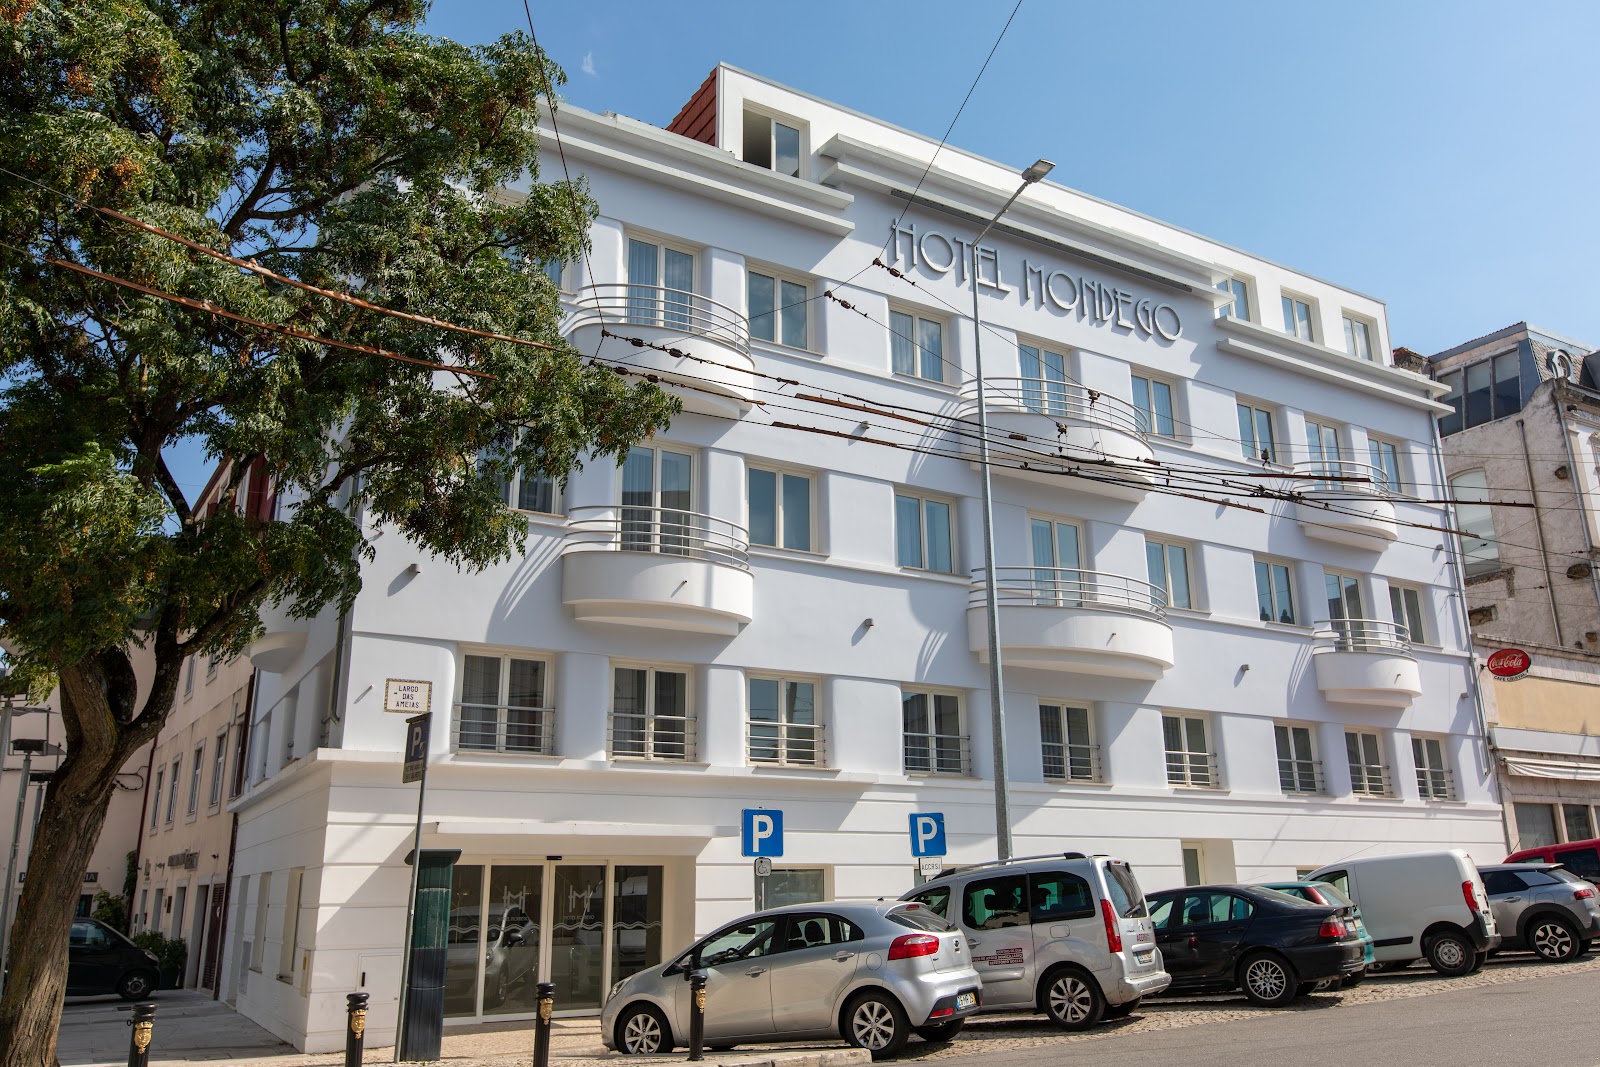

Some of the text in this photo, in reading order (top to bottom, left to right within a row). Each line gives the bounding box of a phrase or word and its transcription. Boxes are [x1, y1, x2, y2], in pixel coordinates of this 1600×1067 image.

[891, 218, 1183, 341] HOTEL MONDEGO
[1488, 653, 1523, 671] Coca-Cola
[398, 685, 419, 693] LARGO
[395, 701, 420, 709] AMEIAS
[411, 726, 422, 757] P
[752, 814, 774, 853] P
[916, 816, 938, 853] P
